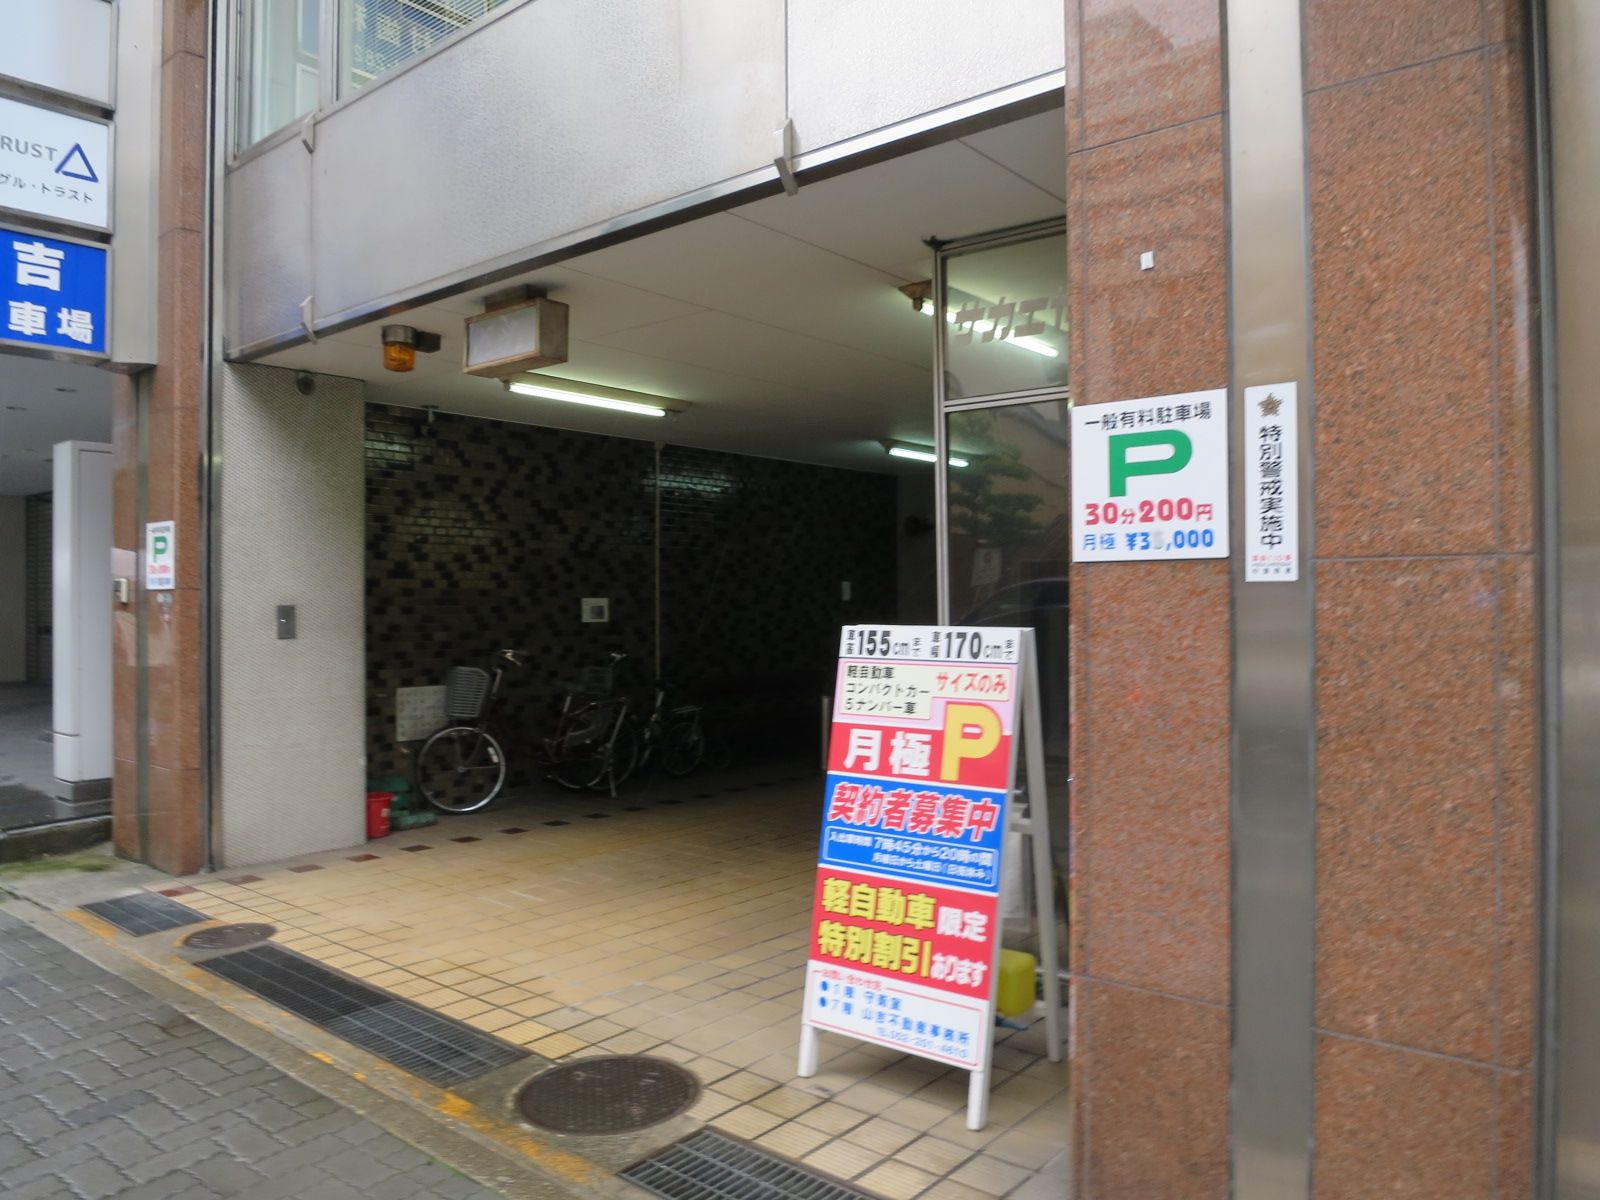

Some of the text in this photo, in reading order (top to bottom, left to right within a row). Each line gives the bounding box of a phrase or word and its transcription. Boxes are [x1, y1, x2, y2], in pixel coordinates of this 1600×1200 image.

[13, 240, 65, 291] 吉
[8, 300, 93, 344] 車場
[1085, 401, 1212, 430] 一般有料駐車場
[1108, 429, 1192, 497] P
[1259, 425, 1283, 550] 特別警戒実施中
[1085, 498, 1213, 526] 30分200円
[1083, 529, 1214, 551] 月極 ¥3,000
[846, 682, 929, 698] コンパクトカー
[847, 665, 894, 679] 軽自動車
[936, 671, 1007, 694] サイズのみ
[843, 728, 932, 777] 月極
[827, 781, 1000, 842] 契約者募集中
